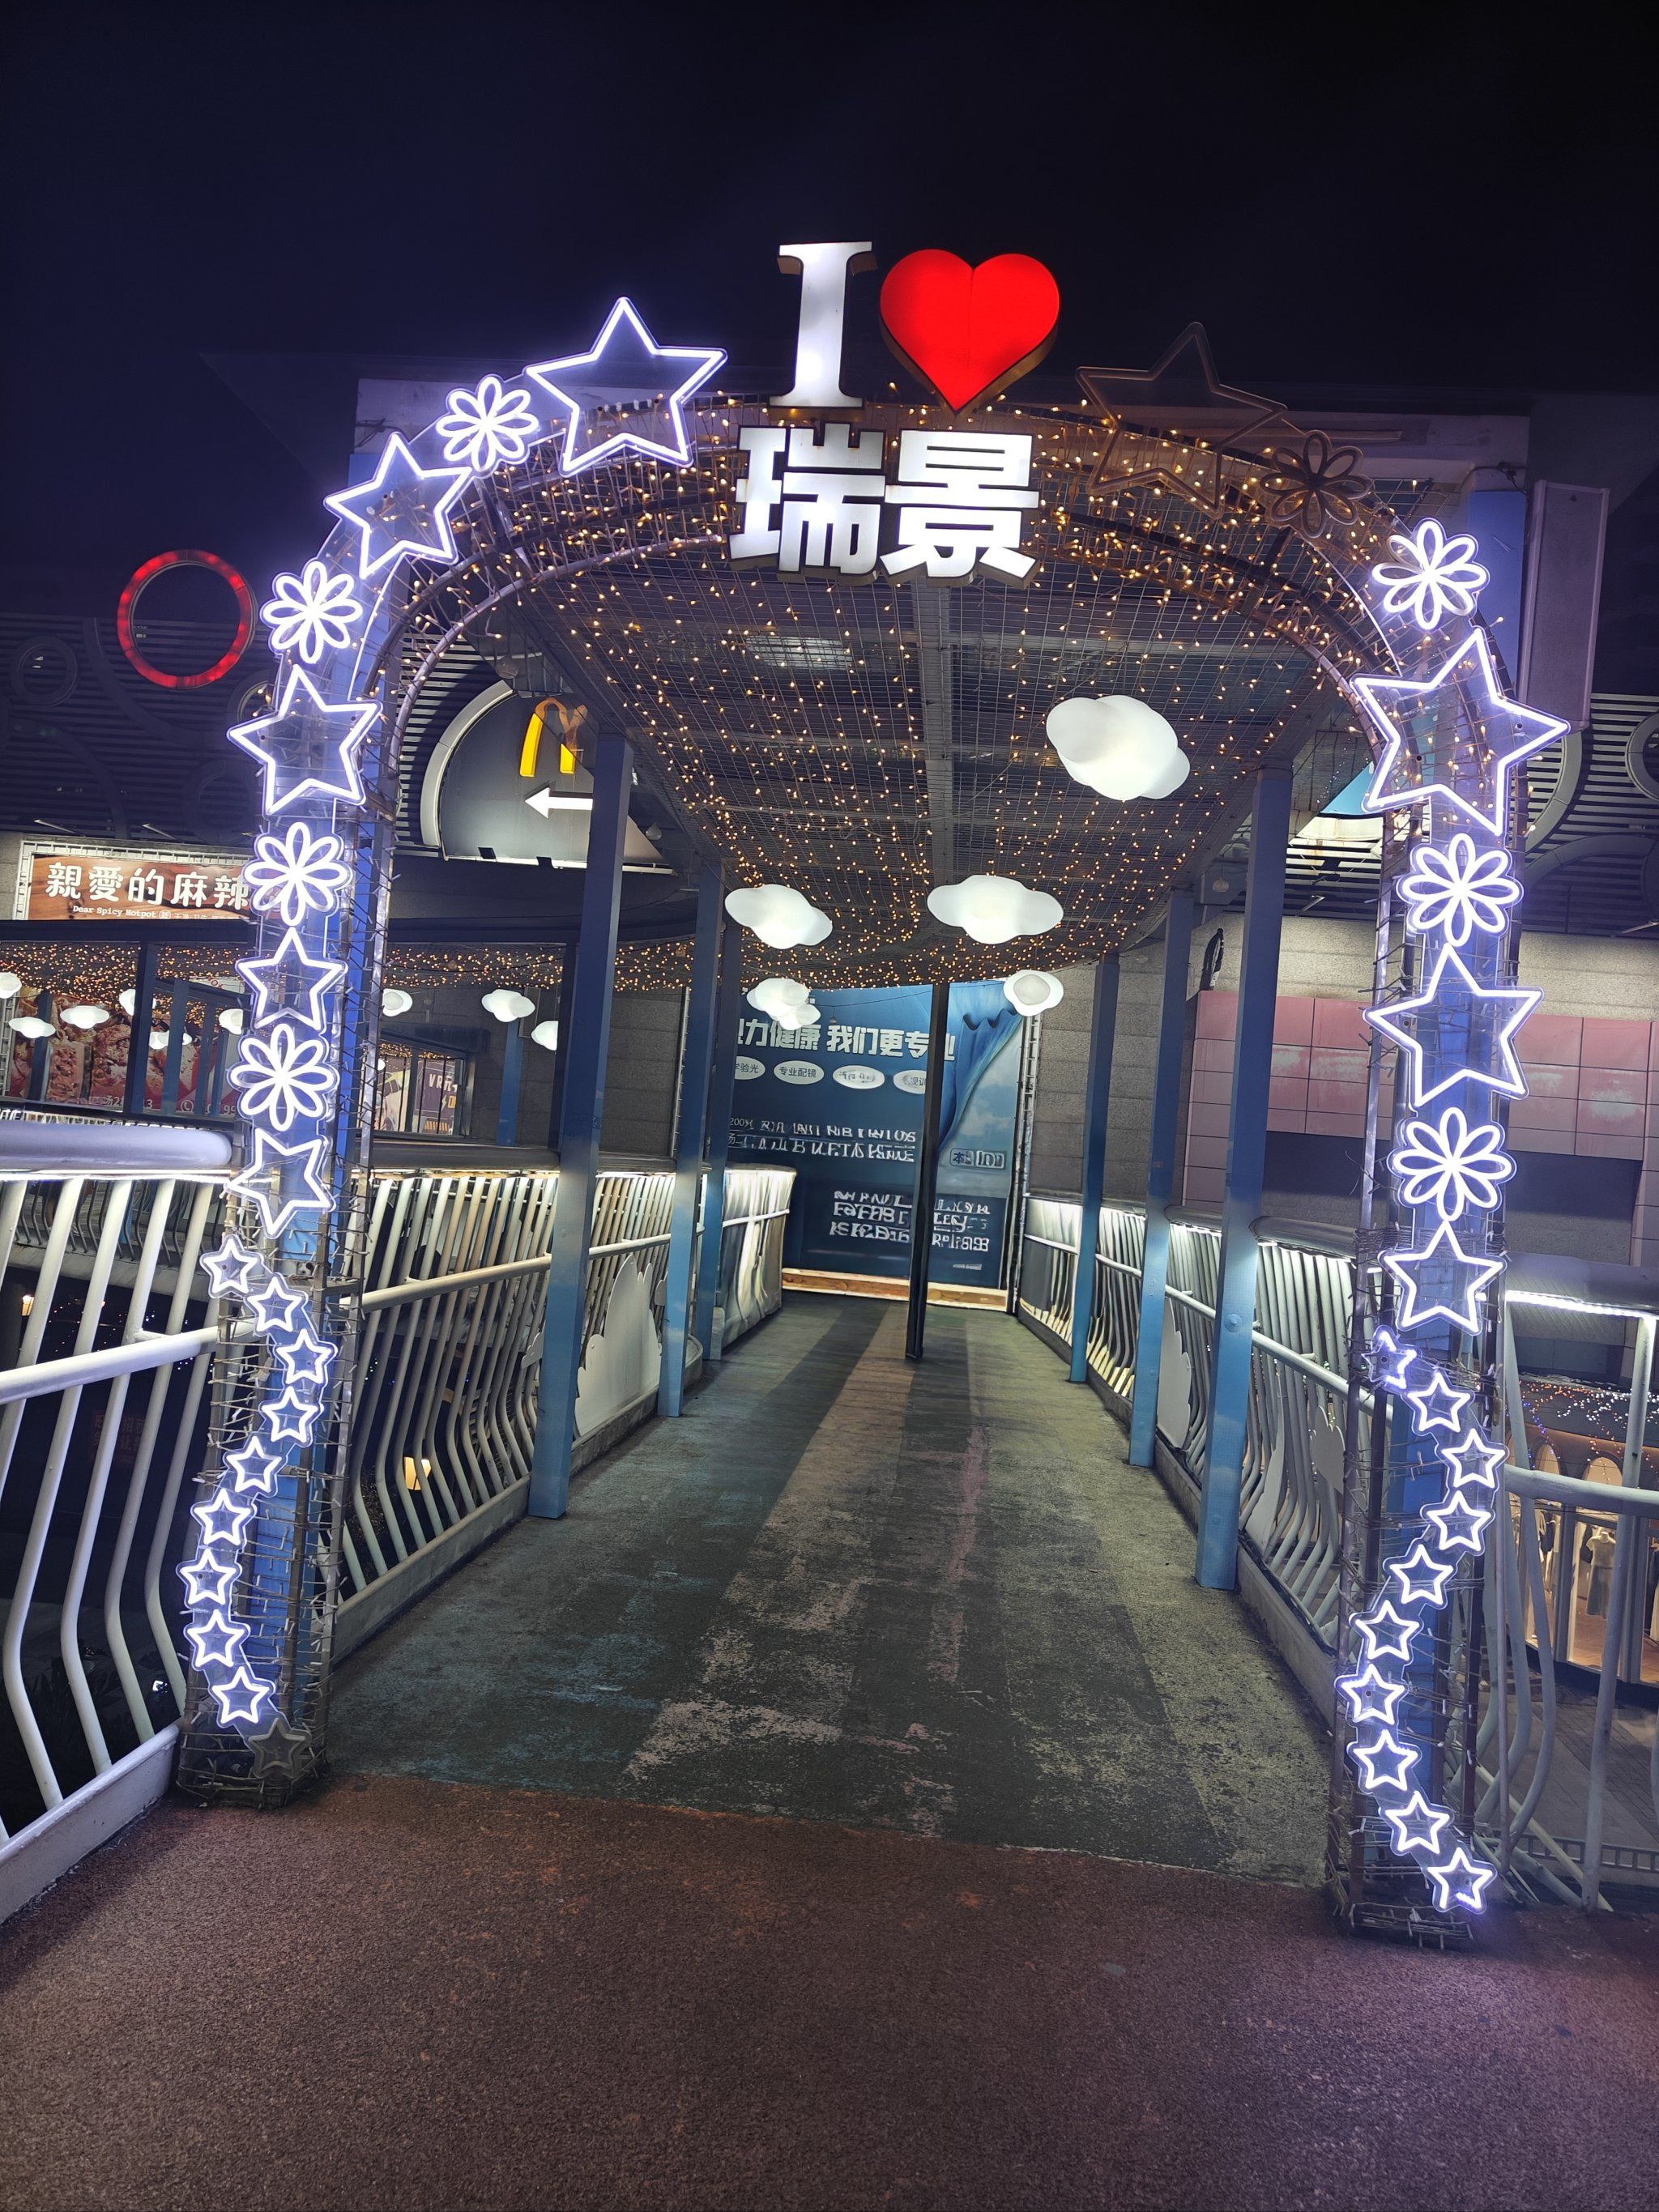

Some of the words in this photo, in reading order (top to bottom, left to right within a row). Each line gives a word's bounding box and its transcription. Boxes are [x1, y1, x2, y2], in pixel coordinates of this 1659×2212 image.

[770, 241, 872, 407] I
[730, 423, 1040, 578] 瑞景
[45, 862, 249, 910] 親愛的麻辣
[73, 906, 94, 914] Dear
[96, 907, 122, 917] Spicy
[126, 910, 157, 918] Hotpot
[737, 1018, 821, 1051] 力健康
[778, 1066, 817, 1078] 专业配镜
